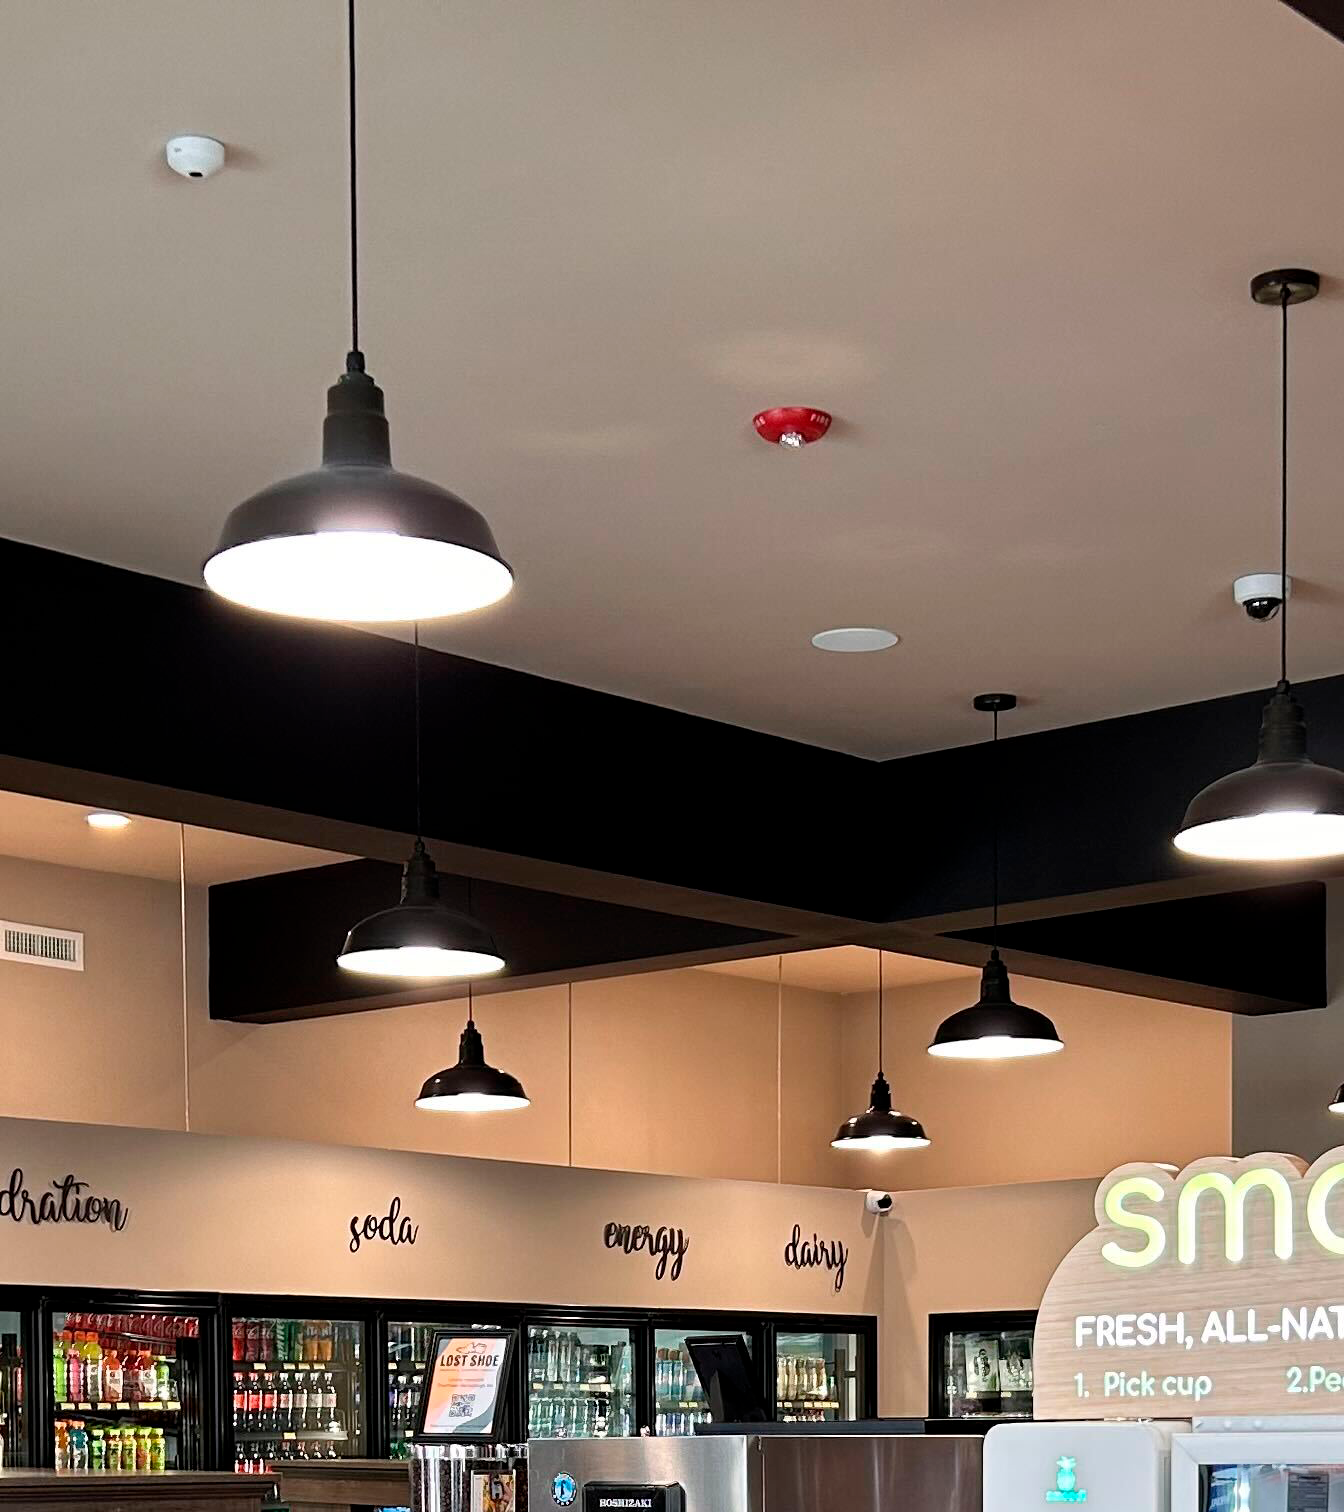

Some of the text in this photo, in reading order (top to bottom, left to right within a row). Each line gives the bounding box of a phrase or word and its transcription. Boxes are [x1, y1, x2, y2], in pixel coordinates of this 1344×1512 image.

[349, 1196, 419, 1252] soda
[603, 1221, 689, 1280] energy
[784, 1225, 848, 1292] dairy
[1074, 1312, 1195, 1350] FRESH,
[440, 1354, 499, 1367] LOST SHOE
[1074, 1373, 1213, 1400] 1. Pick cup
[599, 1498, 652, 1509] HOSHIZAKI
